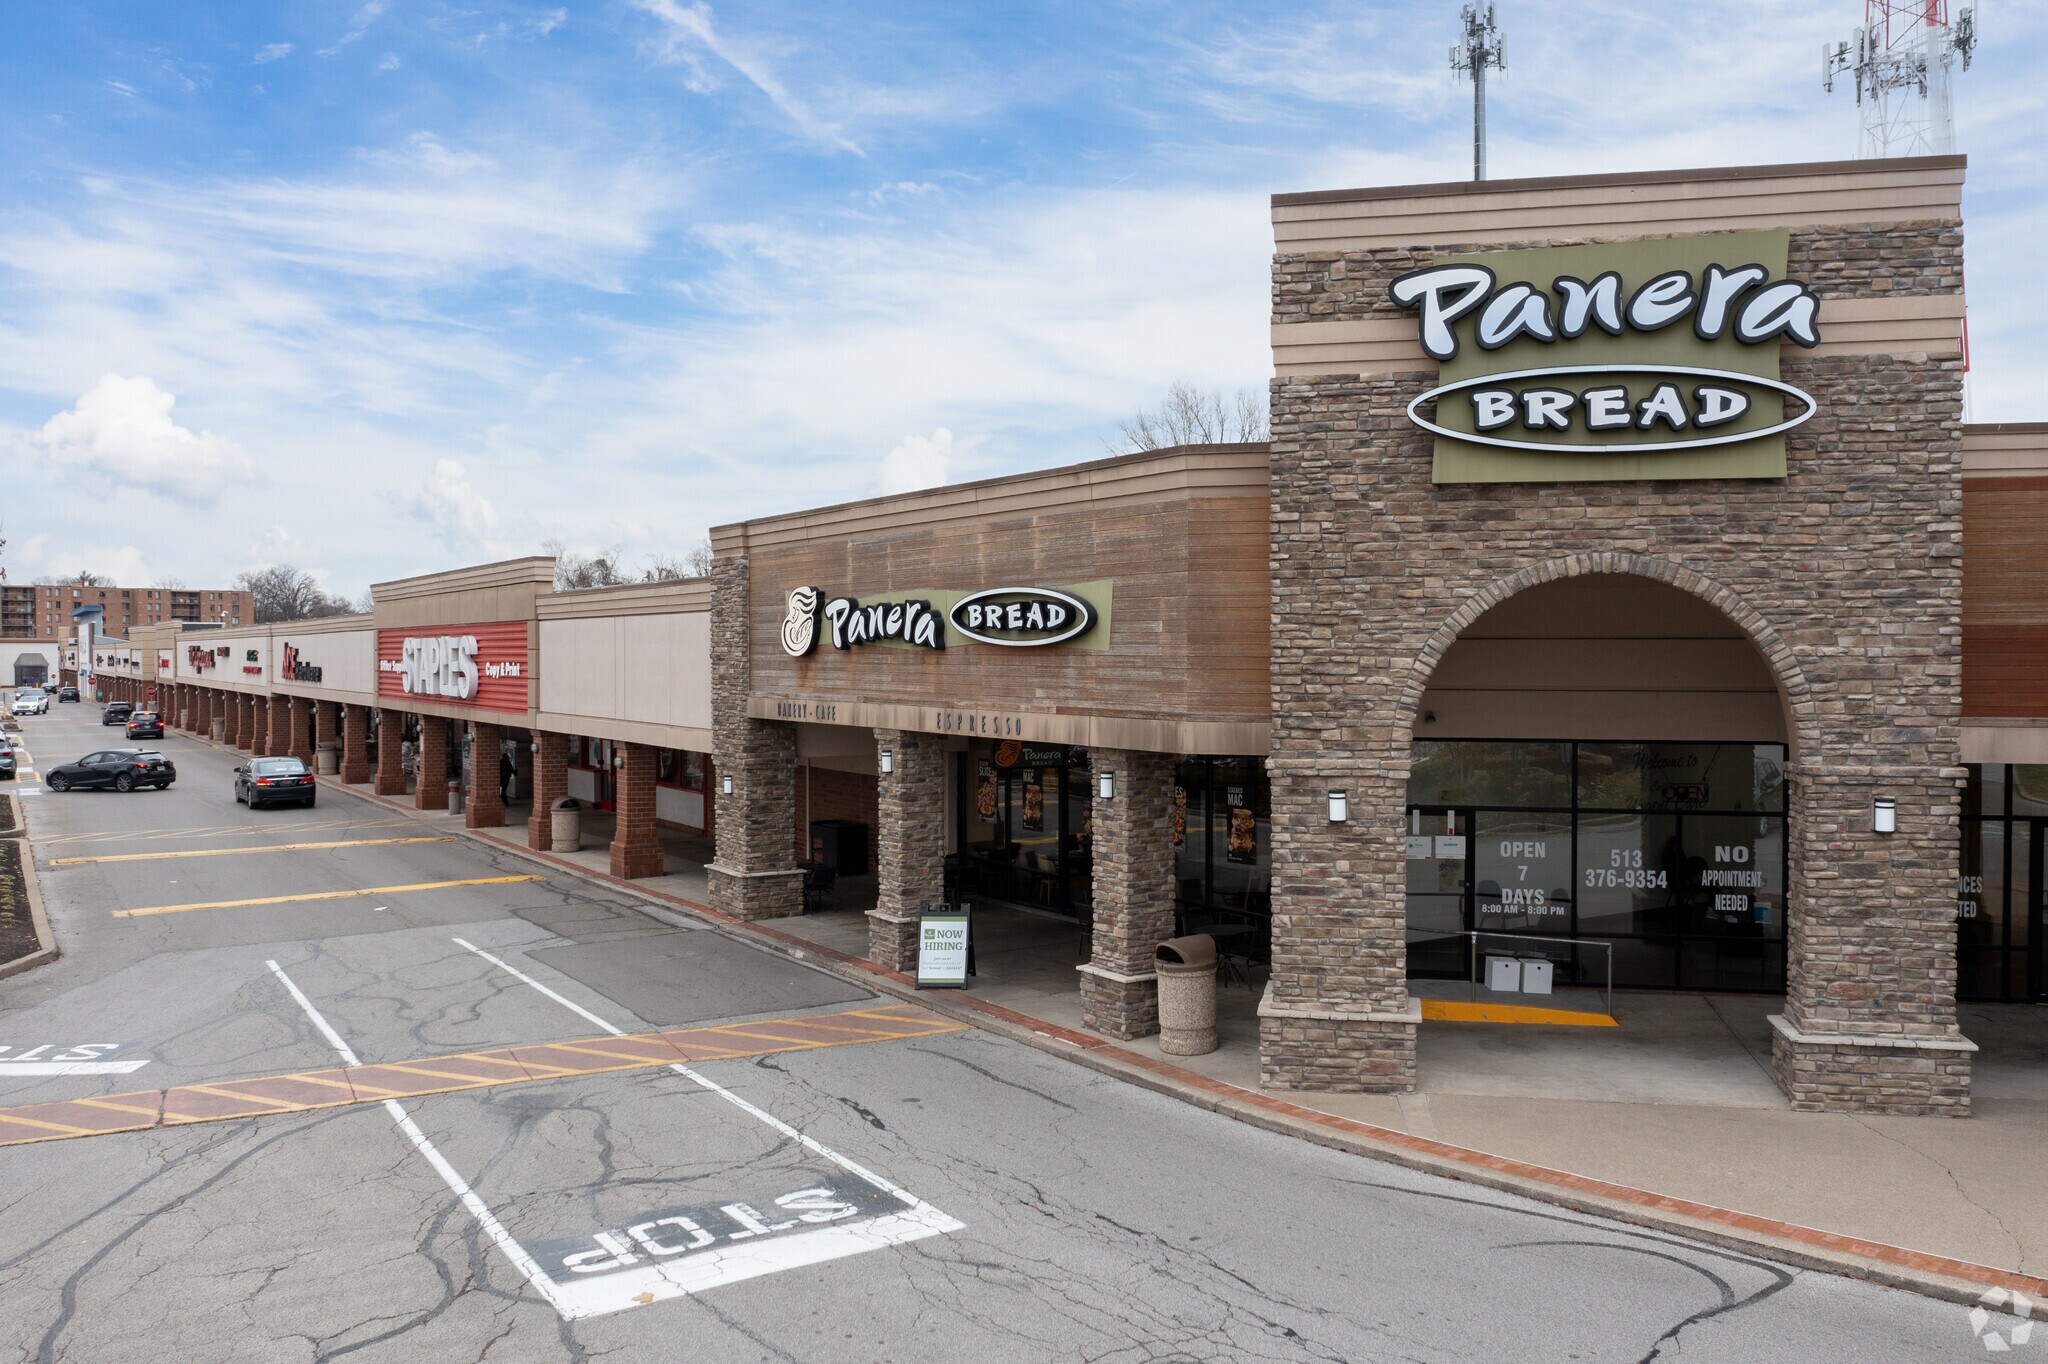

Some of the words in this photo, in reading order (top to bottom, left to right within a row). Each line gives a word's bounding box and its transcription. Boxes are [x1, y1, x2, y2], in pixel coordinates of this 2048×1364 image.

[1389, 263, 1821, 361] Panera
[1468, 382, 1752, 431] BREAD
[825, 597, 941, 649] Panera
[967, 601, 1070, 632] BREAD
[402, 635, 479, 699] STAPLES
[485, 662, 500, 679] Copy
[500, 661, 506, 676] &
[506, 662, 520, 677] Print
[777, 703, 807, 719] BAKERY
[815, 705, 836, 721] CAFE
[936, 712, 1022, 736] ESPRESSO
[1022, 748, 1061, 760] Panera
[1227, 793, 1243, 806] MAC
[1500, 841, 1546, 858] OPEN
[1611, 849, 1642, 868] 513
[1715, 845, 1749, 863] NO
[1517, 866, 1528, 881] 7
[1585, 869, 1667, 889] 376-9354
[1701, 869, 1762, 887] APPOINTMENT
[1502, 888, 1545, 905] DAYS
[1715, 894, 1748, 911] NEEDED
[1482, 904, 1501, 913] 8:00
[1504, 905, 1518, 914] AM
[1527, 905, 1547, 915] 8:00
[1550, 907, 1564, 916] PM
[936, 930, 963, 939] NOW
[924, 942, 963, 951] HIRING
[0, 1043, 120, 1062] ST
[562, 1187, 858, 1273] STOP
